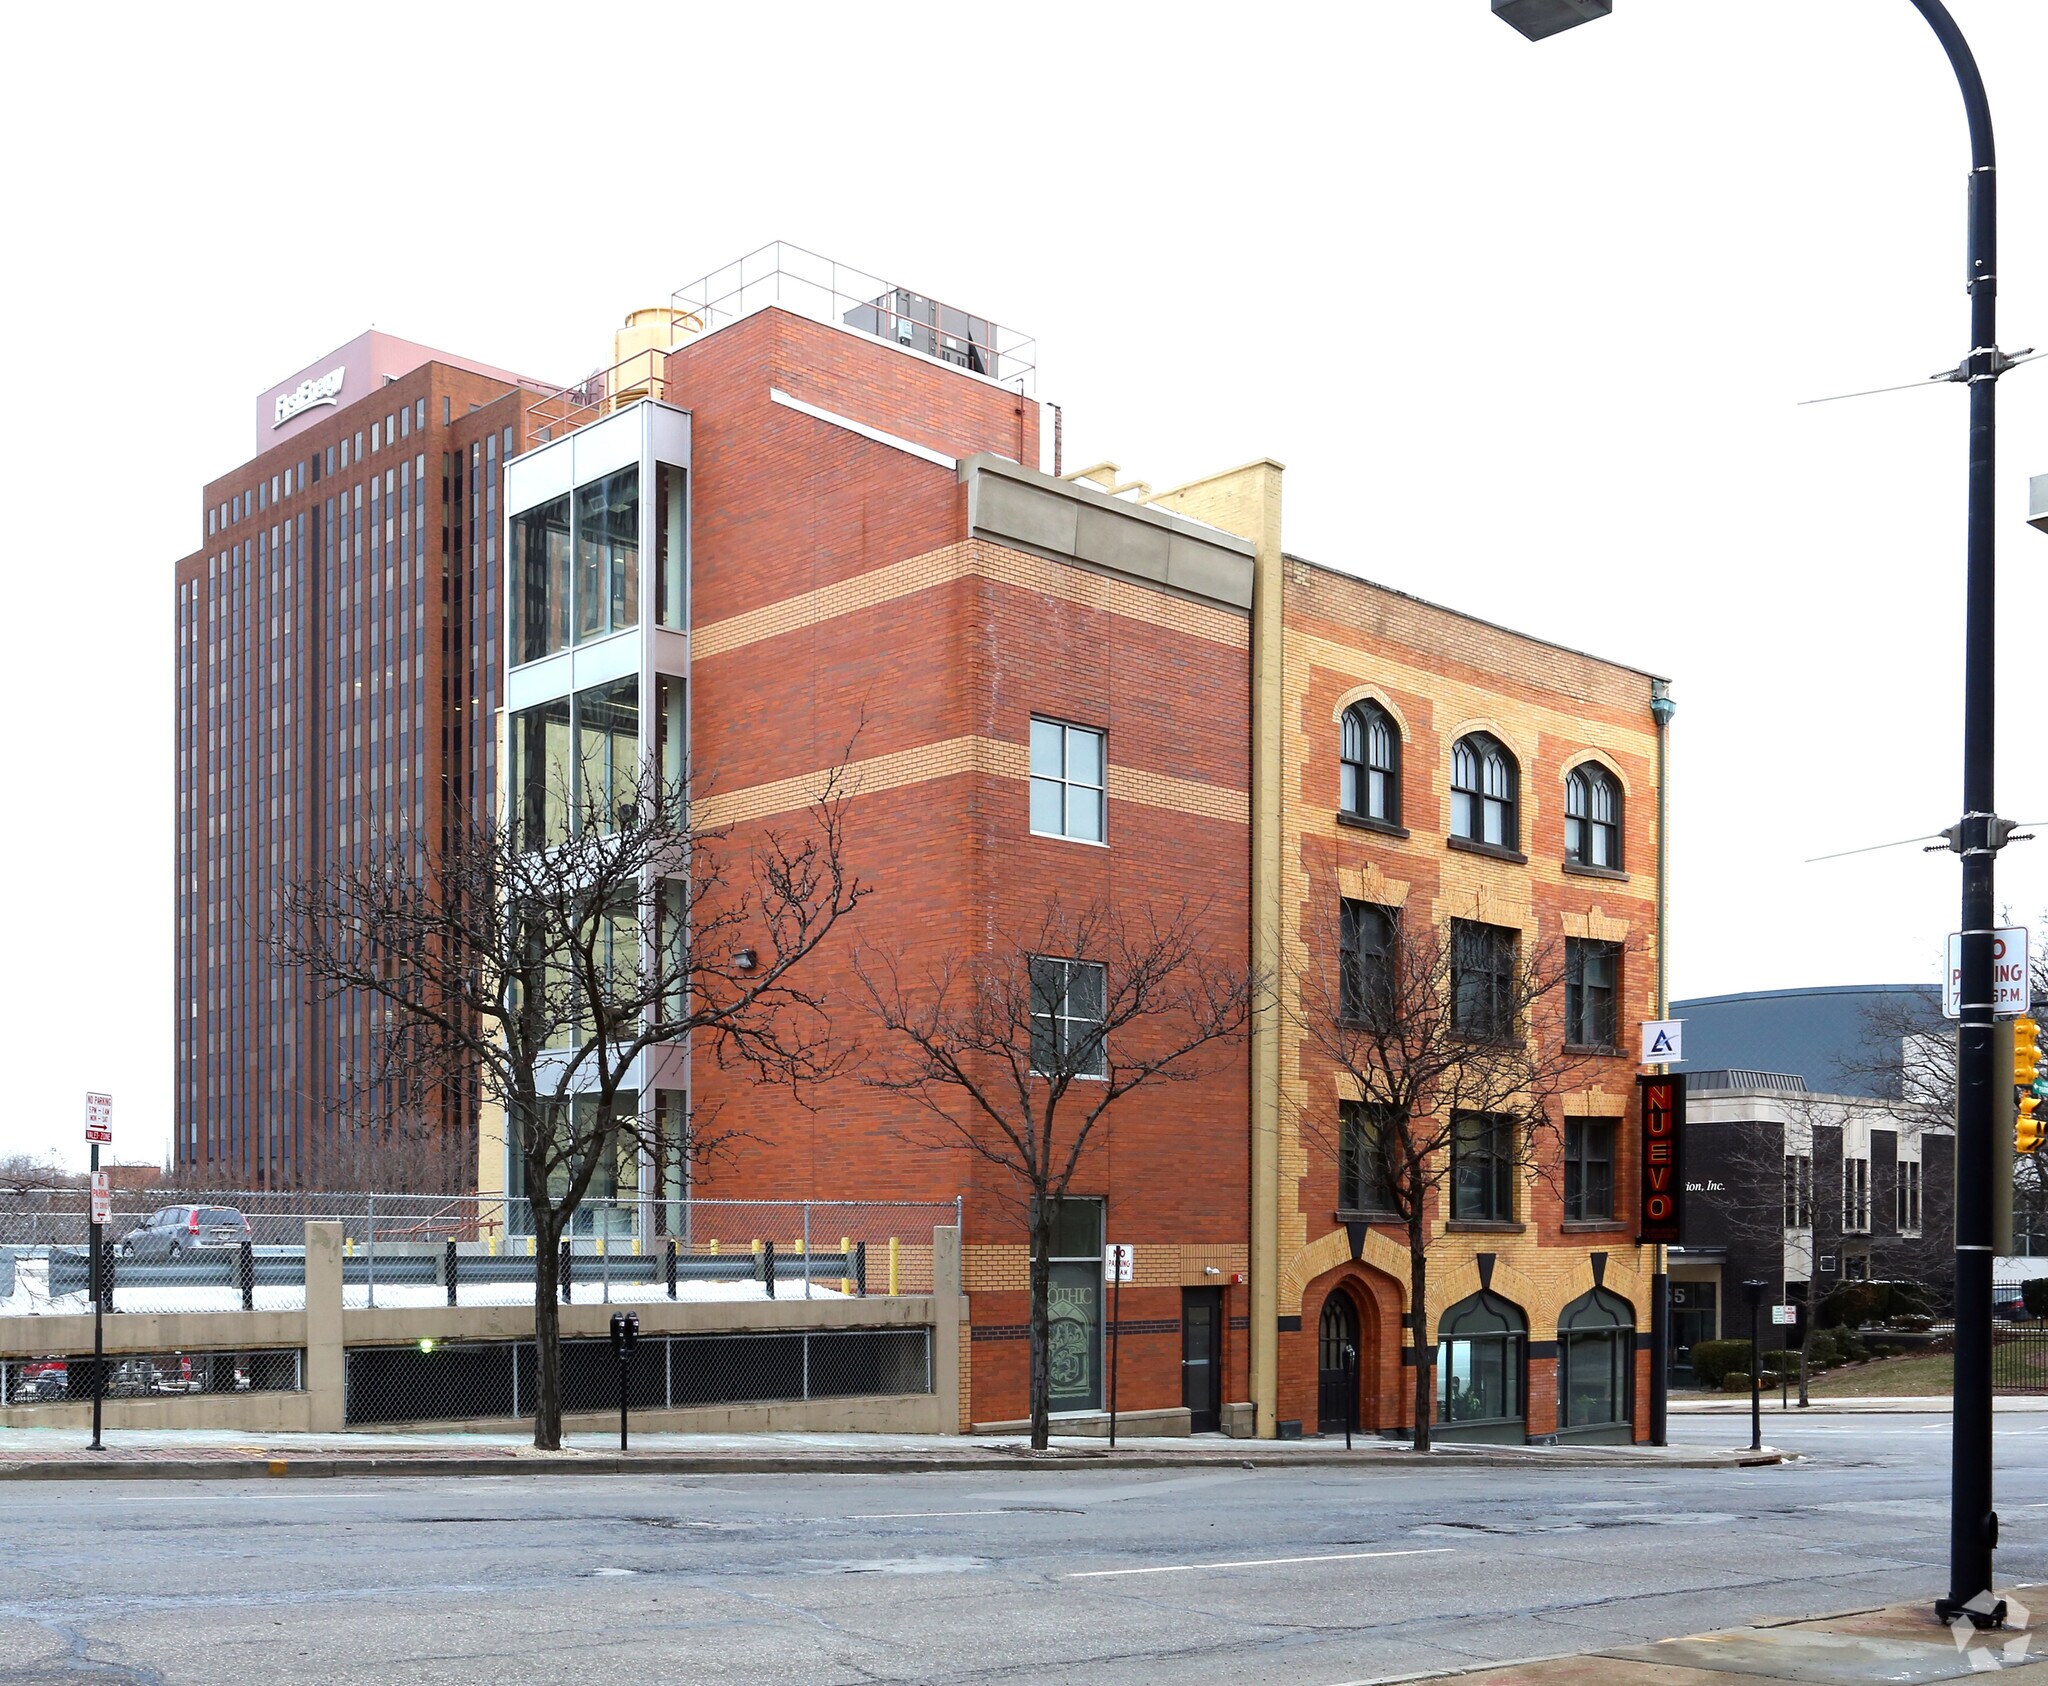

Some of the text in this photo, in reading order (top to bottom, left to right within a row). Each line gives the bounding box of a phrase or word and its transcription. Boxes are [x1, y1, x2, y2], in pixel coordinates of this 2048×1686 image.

[1993, 939, 2006, 959] O
[1648, 1084, 1672, 1220] NUEVO
[1685, 1179, 1726, 1192] ion, Inc.
[1047, 1287, 1093, 1305] OTHIC
